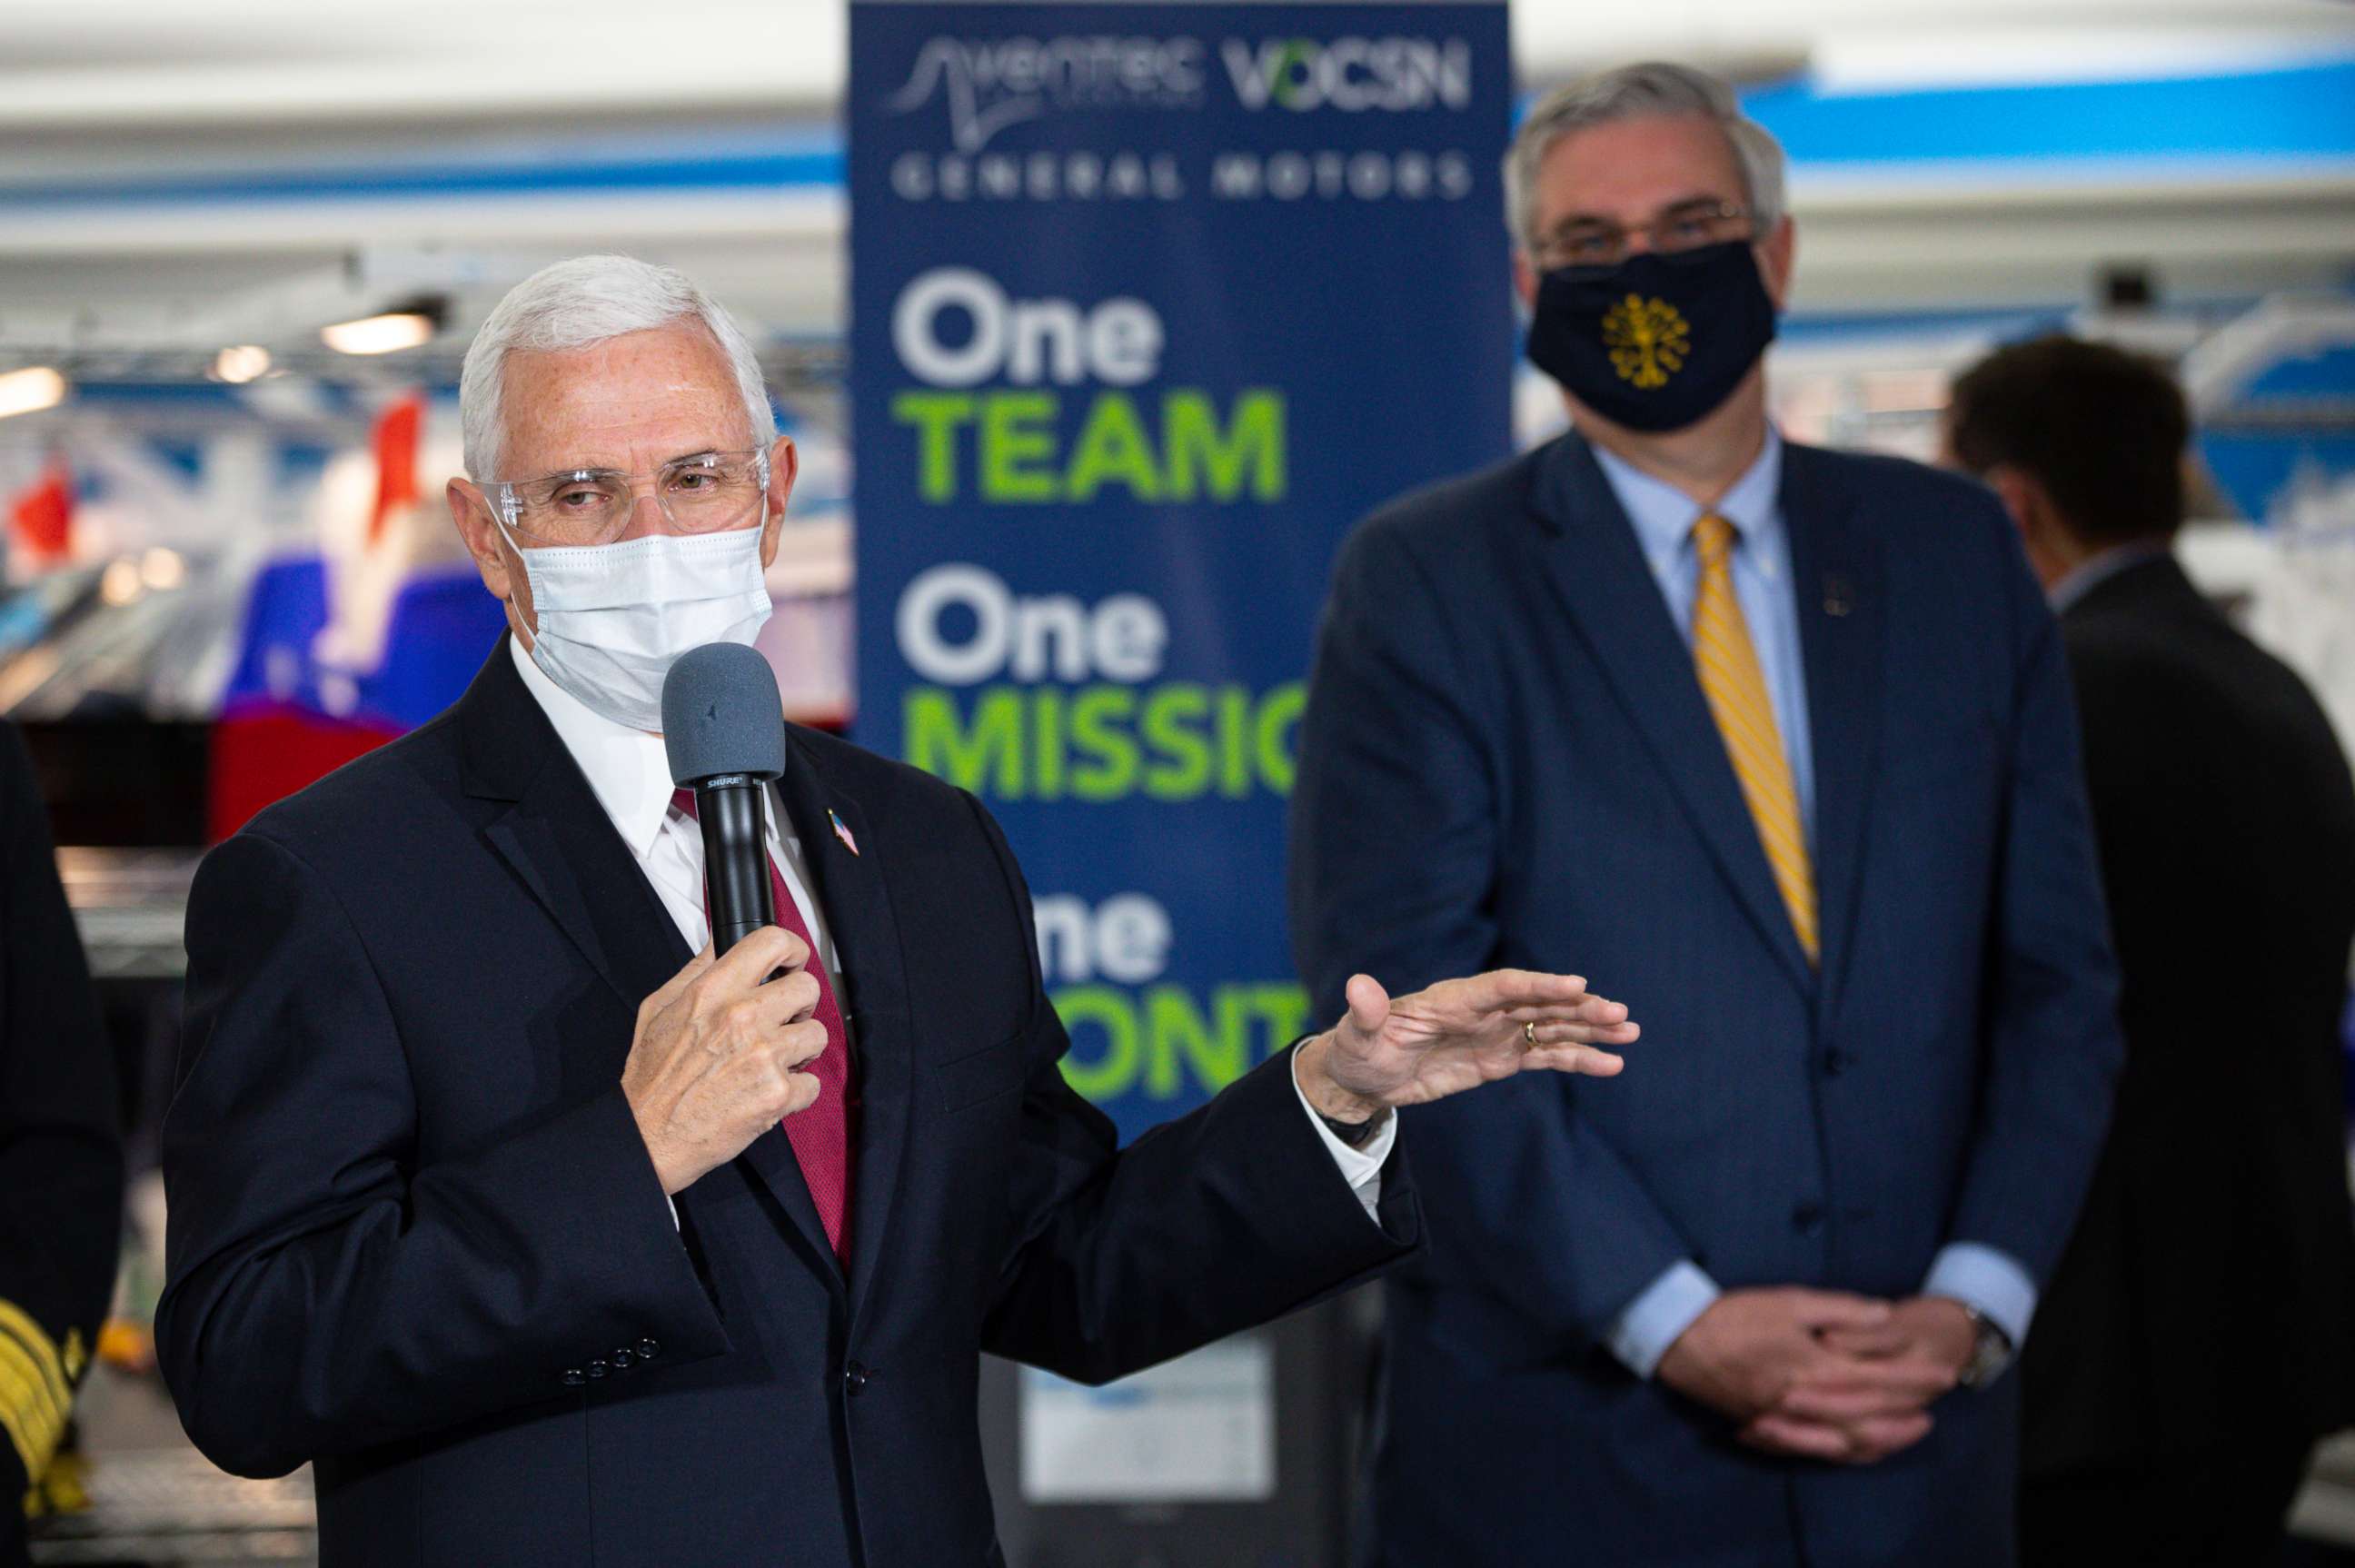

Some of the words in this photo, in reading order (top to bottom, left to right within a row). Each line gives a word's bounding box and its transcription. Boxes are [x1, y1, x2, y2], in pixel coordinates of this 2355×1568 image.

[893, 153, 1183, 200] GENERAL
[1213, 151, 1469, 200] MOTORS
[894, 268, 1162, 385] One
[893, 391, 1284, 501] TEAM
[897, 565, 1167, 684] One
[707, 776, 740, 789] SHURE
[1032, 892, 1172, 983] ne
